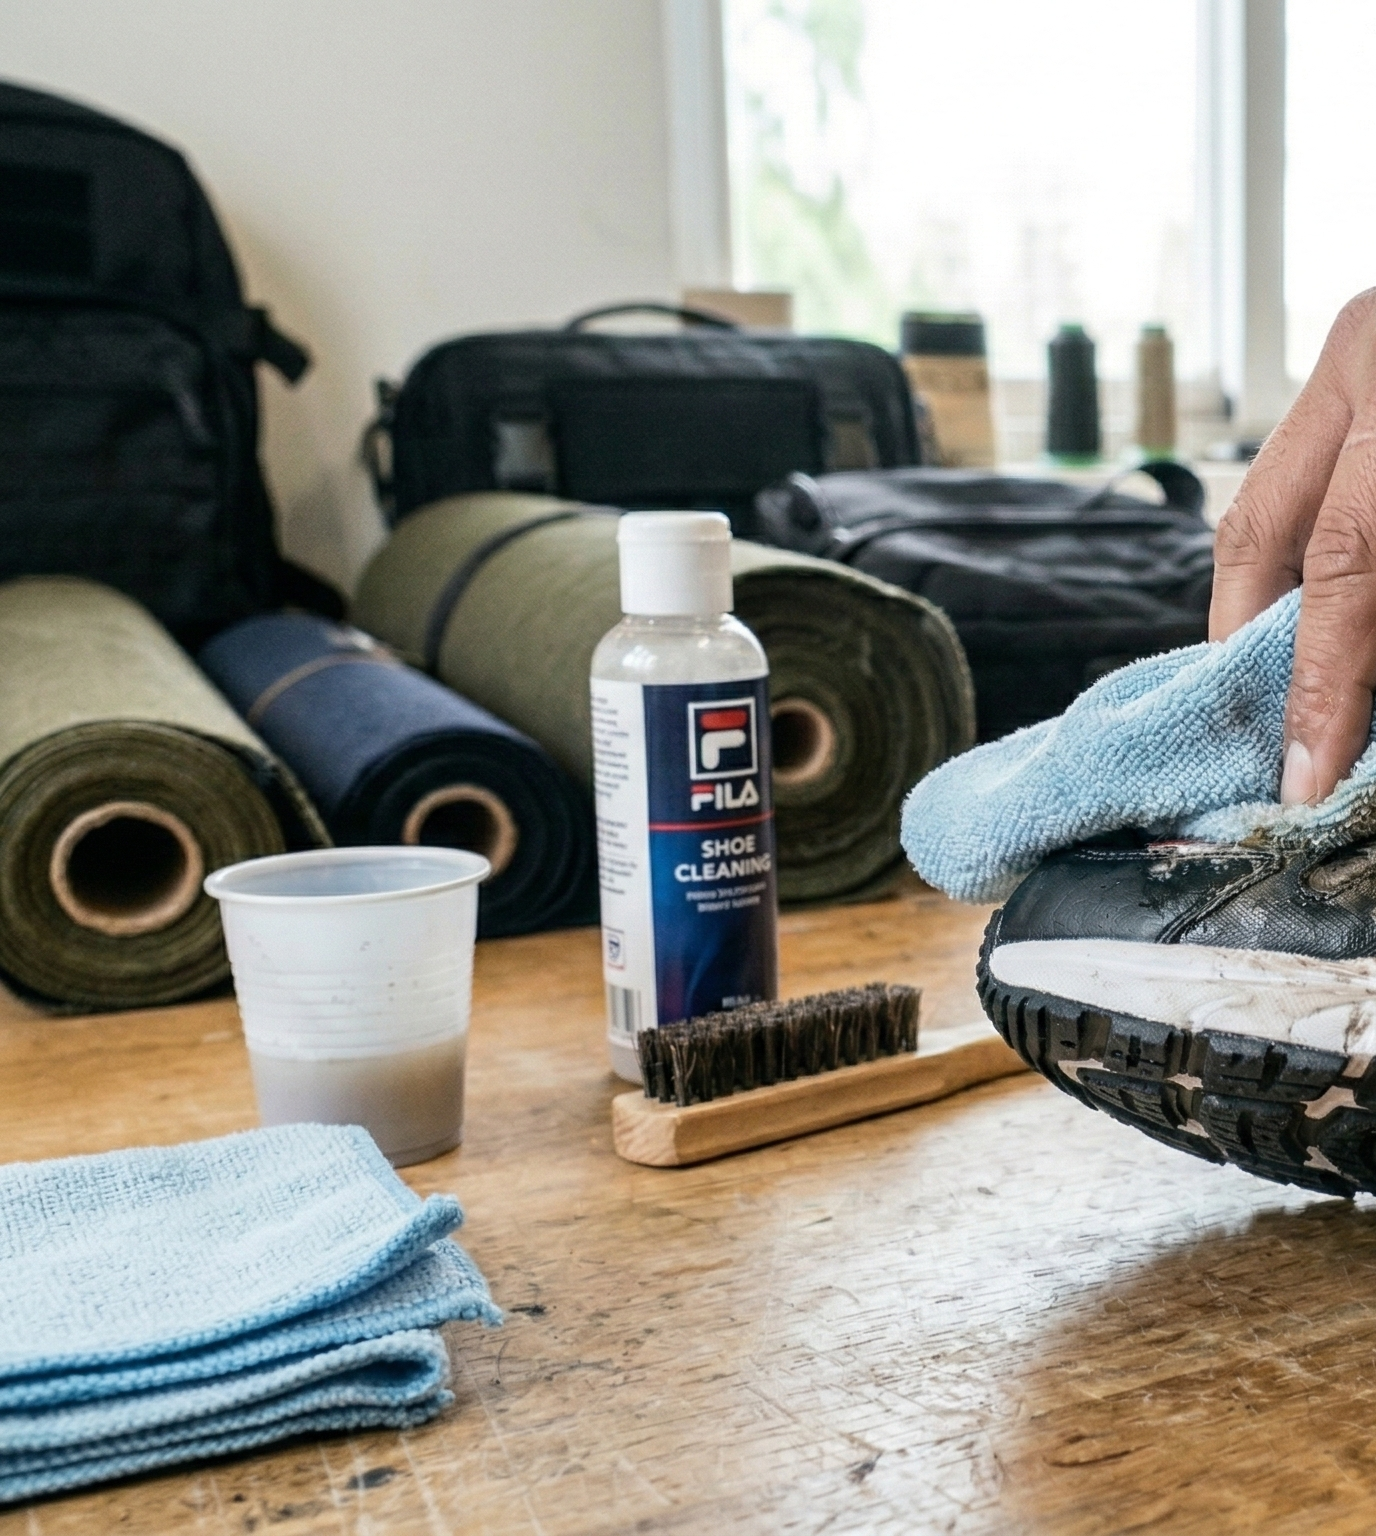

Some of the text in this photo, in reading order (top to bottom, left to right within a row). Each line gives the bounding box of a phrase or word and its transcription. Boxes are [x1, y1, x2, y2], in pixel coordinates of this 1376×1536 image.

[690, 779, 759, 812] FILA
[701, 834, 756, 859] SHOE
[674, 852, 771, 883] CLEANING
